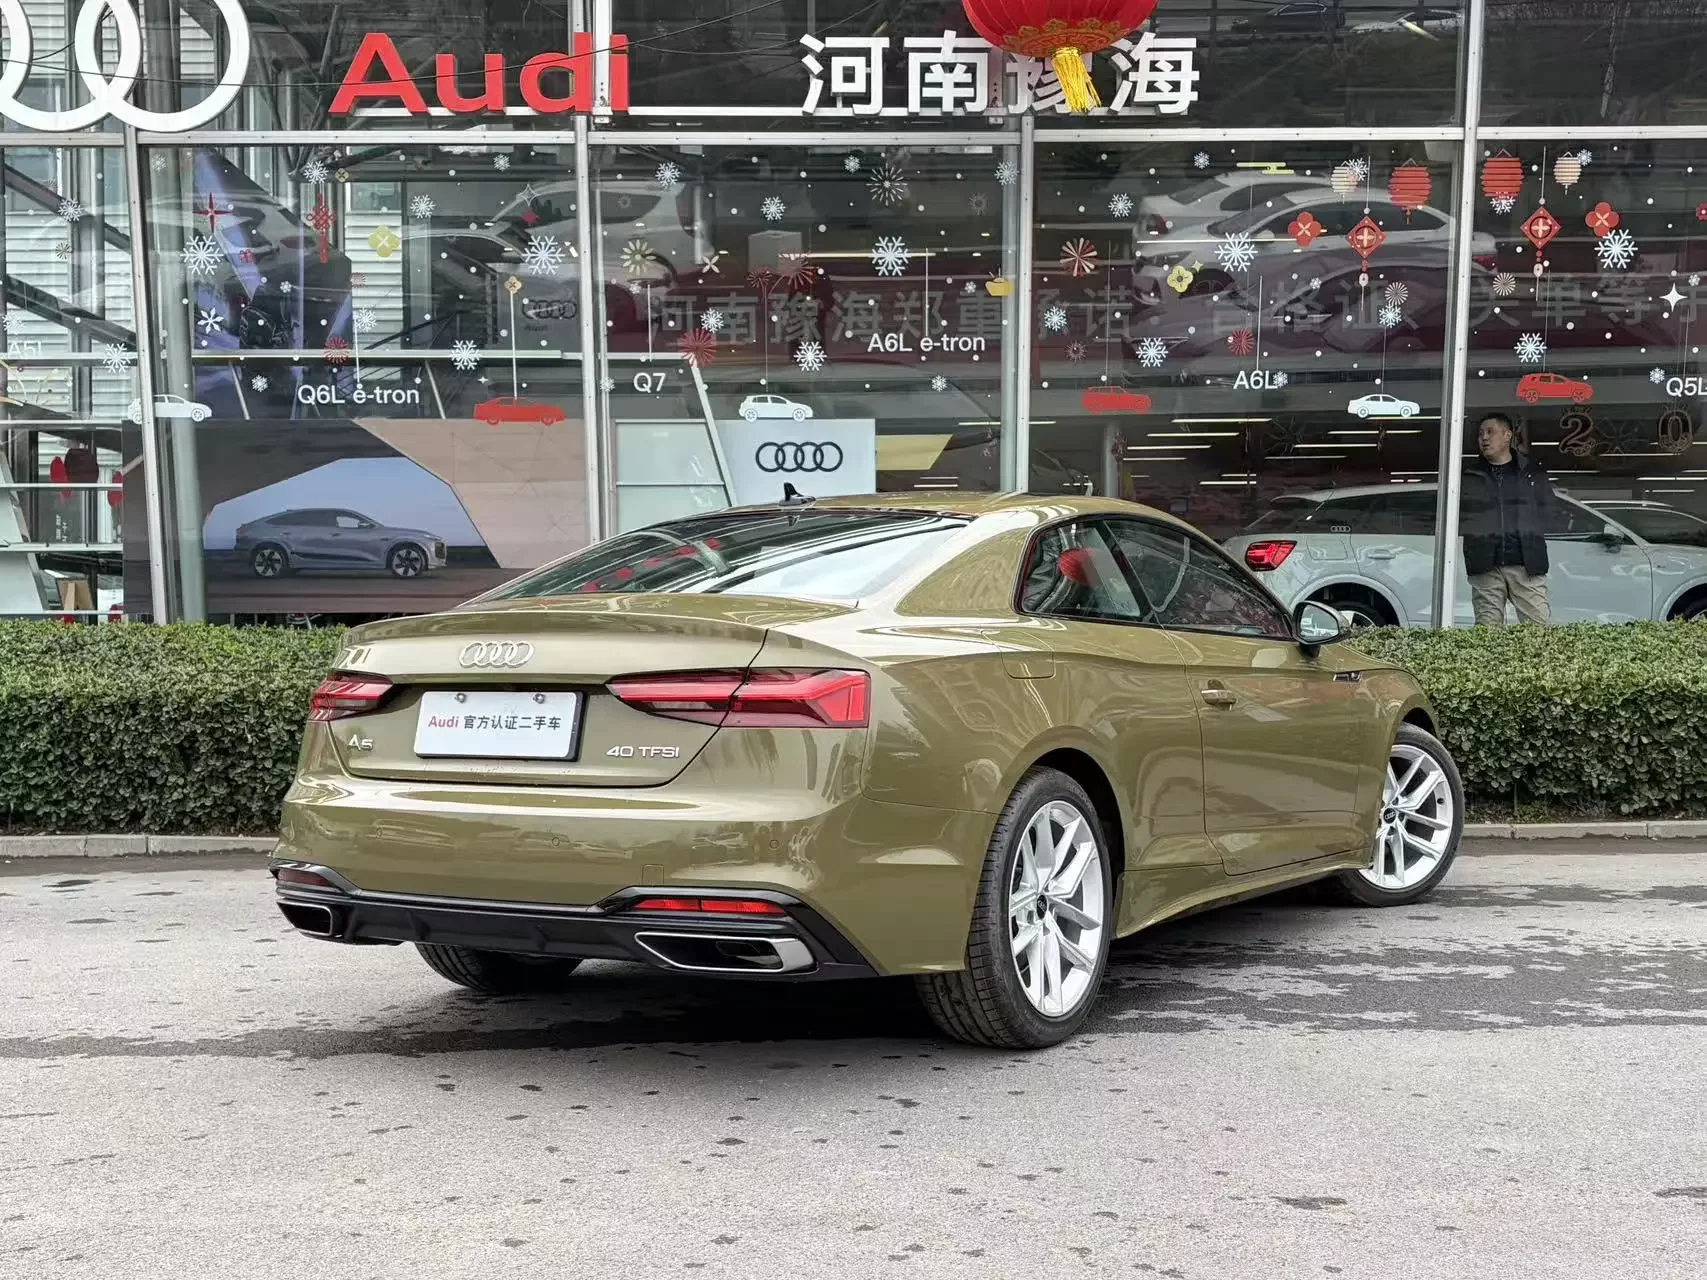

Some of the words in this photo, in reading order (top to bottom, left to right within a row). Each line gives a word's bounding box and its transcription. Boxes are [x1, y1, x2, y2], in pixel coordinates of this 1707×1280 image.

[328, 32, 629, 114] Audi
[867, 333, 912, 352] A6L
[920, 334, 985, 351] e-tron
[633, 372, 666, 393] Q7
[1233, 370, 1278, 389] A6L
[1666, 377, 1707, 397] Q5L
[298, 385, 345, 405] Q6L
[353, 386, 420, 404] e-tron
[428, 716, 459, 728] Audi
[464, 715, 561, 731] 官方认证二手车
[347, 734, 374, 751] A5
[606, 745, 634, 757] 40
[638, 746, 680, 758] TFSI
